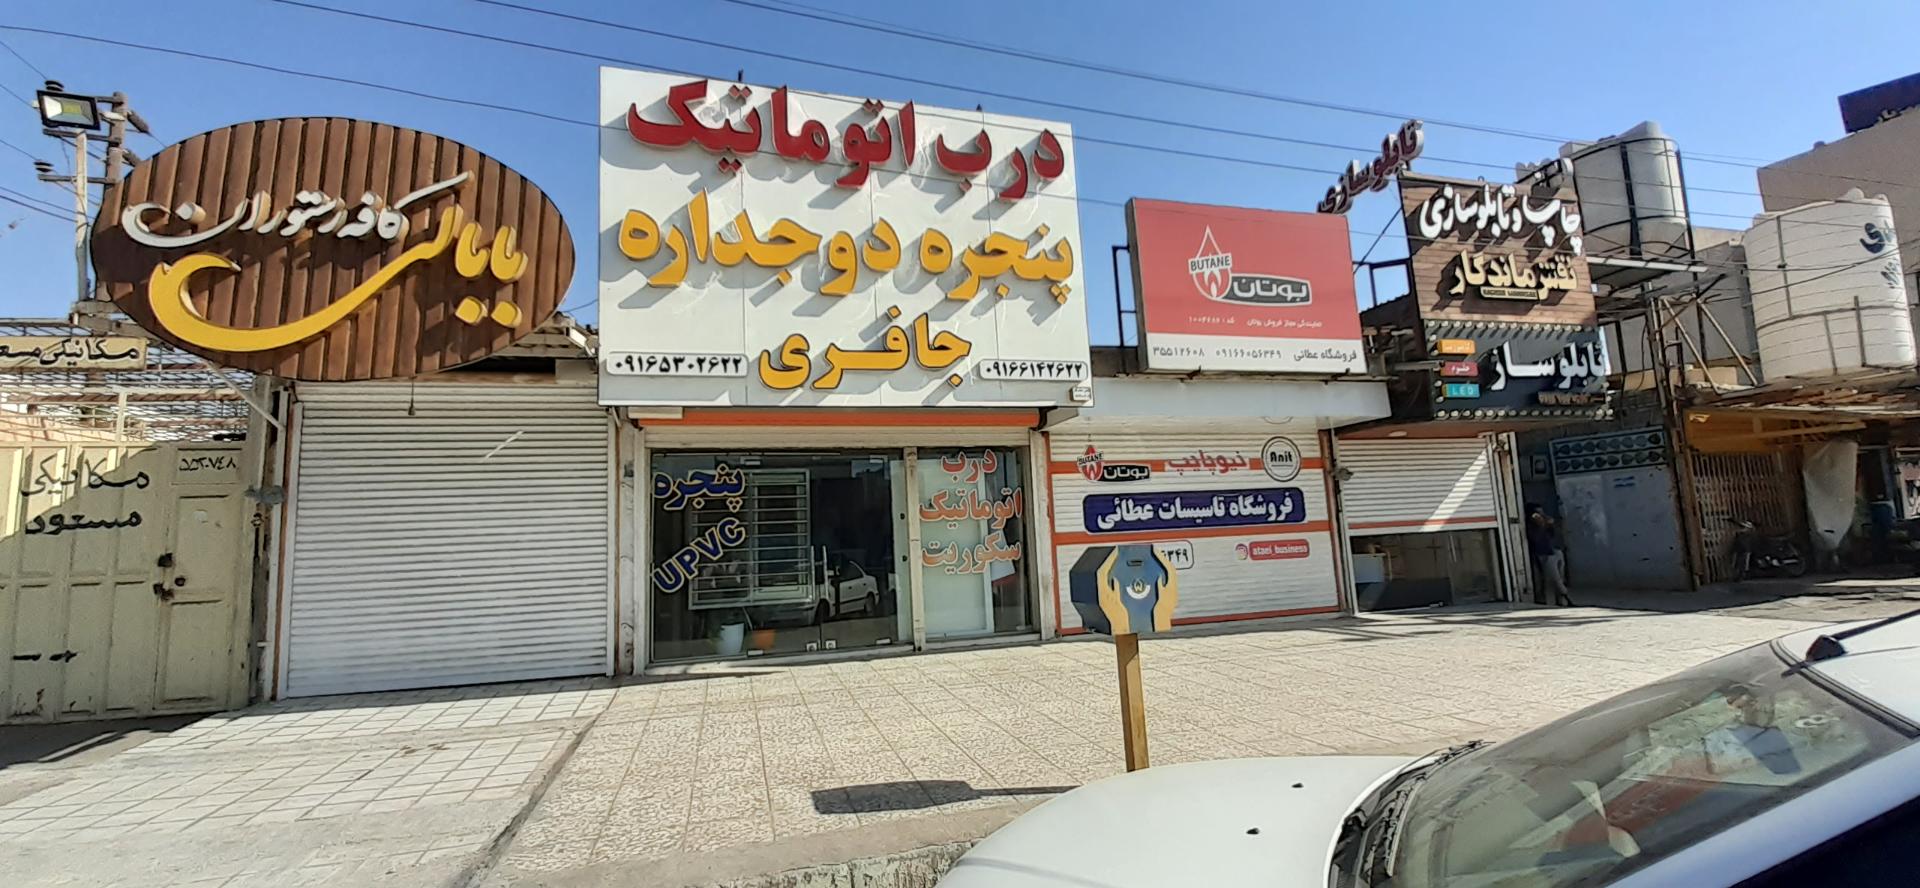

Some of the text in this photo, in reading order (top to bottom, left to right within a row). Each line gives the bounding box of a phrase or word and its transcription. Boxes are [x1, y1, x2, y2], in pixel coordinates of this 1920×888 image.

[627, 78, 1065, 200] درب اتوماتیک
[121, 170, 474, 248] کافه رستوران
[1419, 184, 1516, 239] تابلوسازی
[1522, 195, 1583, 257] چاپ
[918, 223, 1074, 304] پنجره
[1190, 255, 1232, 272] BUTANE
[1449, 249, 1578, 300] نقش ماندگار
[1232, 277, 1309, 302] بوتان
[39, 337, 141, 367] مکانیکی
[615, 353, 743, 374] ۰۹۱۶۵۳۰۲۶۲۲
[758, 306, 972, 389] جافری
[1321, 347, 1358, 362] فروشگاه
[985, 360, 1083, 379] ۰۹۱۶۶۱۴۲۶۲۲
[20, 453, 150, 497] مکانیکی
[941, 448, 998, 484] درب
[1077, 451, 1104, 466] BUTANE
[1103, 465, 1150, 480] بوتان
[1167, 449, 1248, 477] نیوپایپ
[1269, 450, 1293, 464] Anit
[653, 463, 746, 513] پنجره
[25, 510, 142, 536] مسعود
[918, 487, 1023, 530] اتوماتیک
[1096, 491, 1294, 530] فروشگاه تاسیسات عطائی
[652, 517, 746, 594] UPVC
[920, 533, 1022, 575] سکوریت
